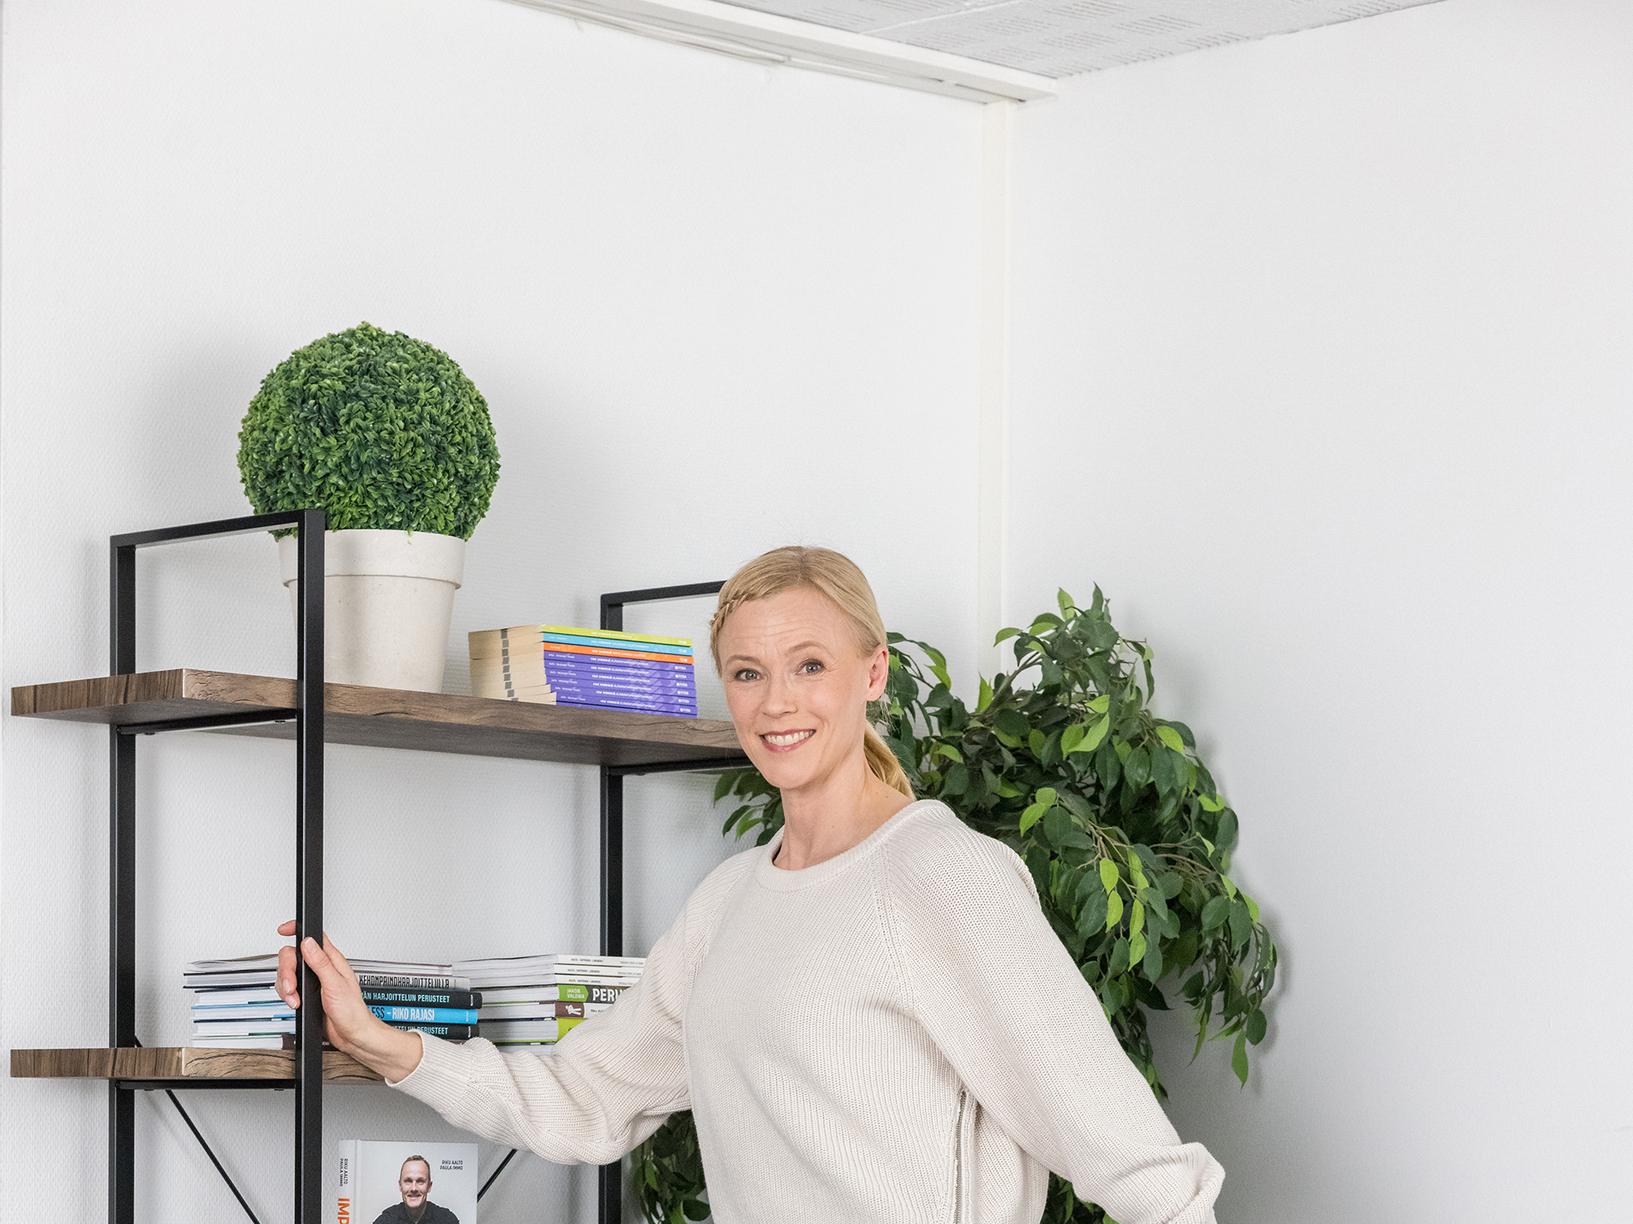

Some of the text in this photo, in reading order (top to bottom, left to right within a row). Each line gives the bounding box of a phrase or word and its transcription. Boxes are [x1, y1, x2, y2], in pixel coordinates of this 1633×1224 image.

[372, 992, 416, 1002] HARJOITTELUN
[418, 994, 450, 1003] PERUSTEET
[392, 1008, 408, 1020] RIKO
[410, 1008, 435, 1020] RAJASI
